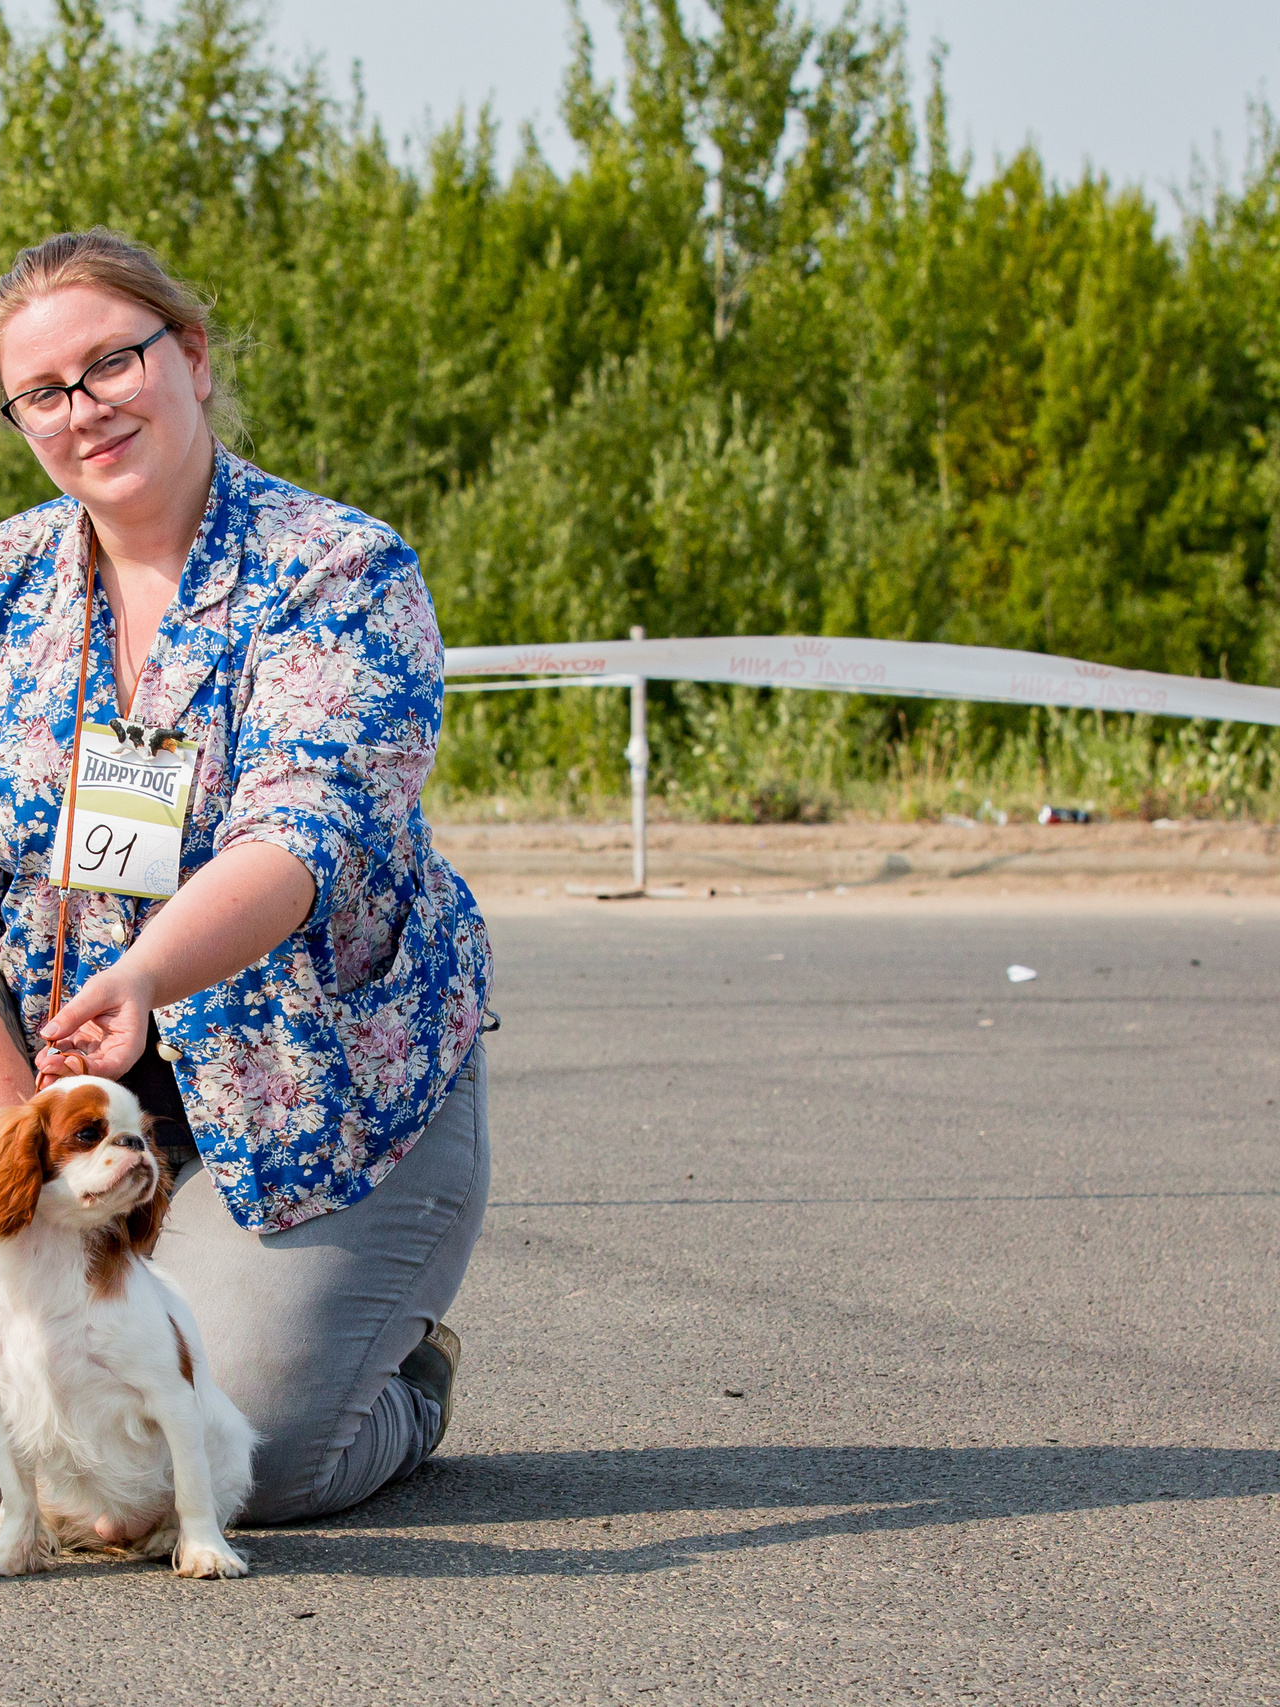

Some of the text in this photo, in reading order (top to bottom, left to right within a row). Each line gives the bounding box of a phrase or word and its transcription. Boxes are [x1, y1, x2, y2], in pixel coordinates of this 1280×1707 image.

[82, 755, 177, 797] HAPPY DOG
[78, 824, 138, 877] 91
